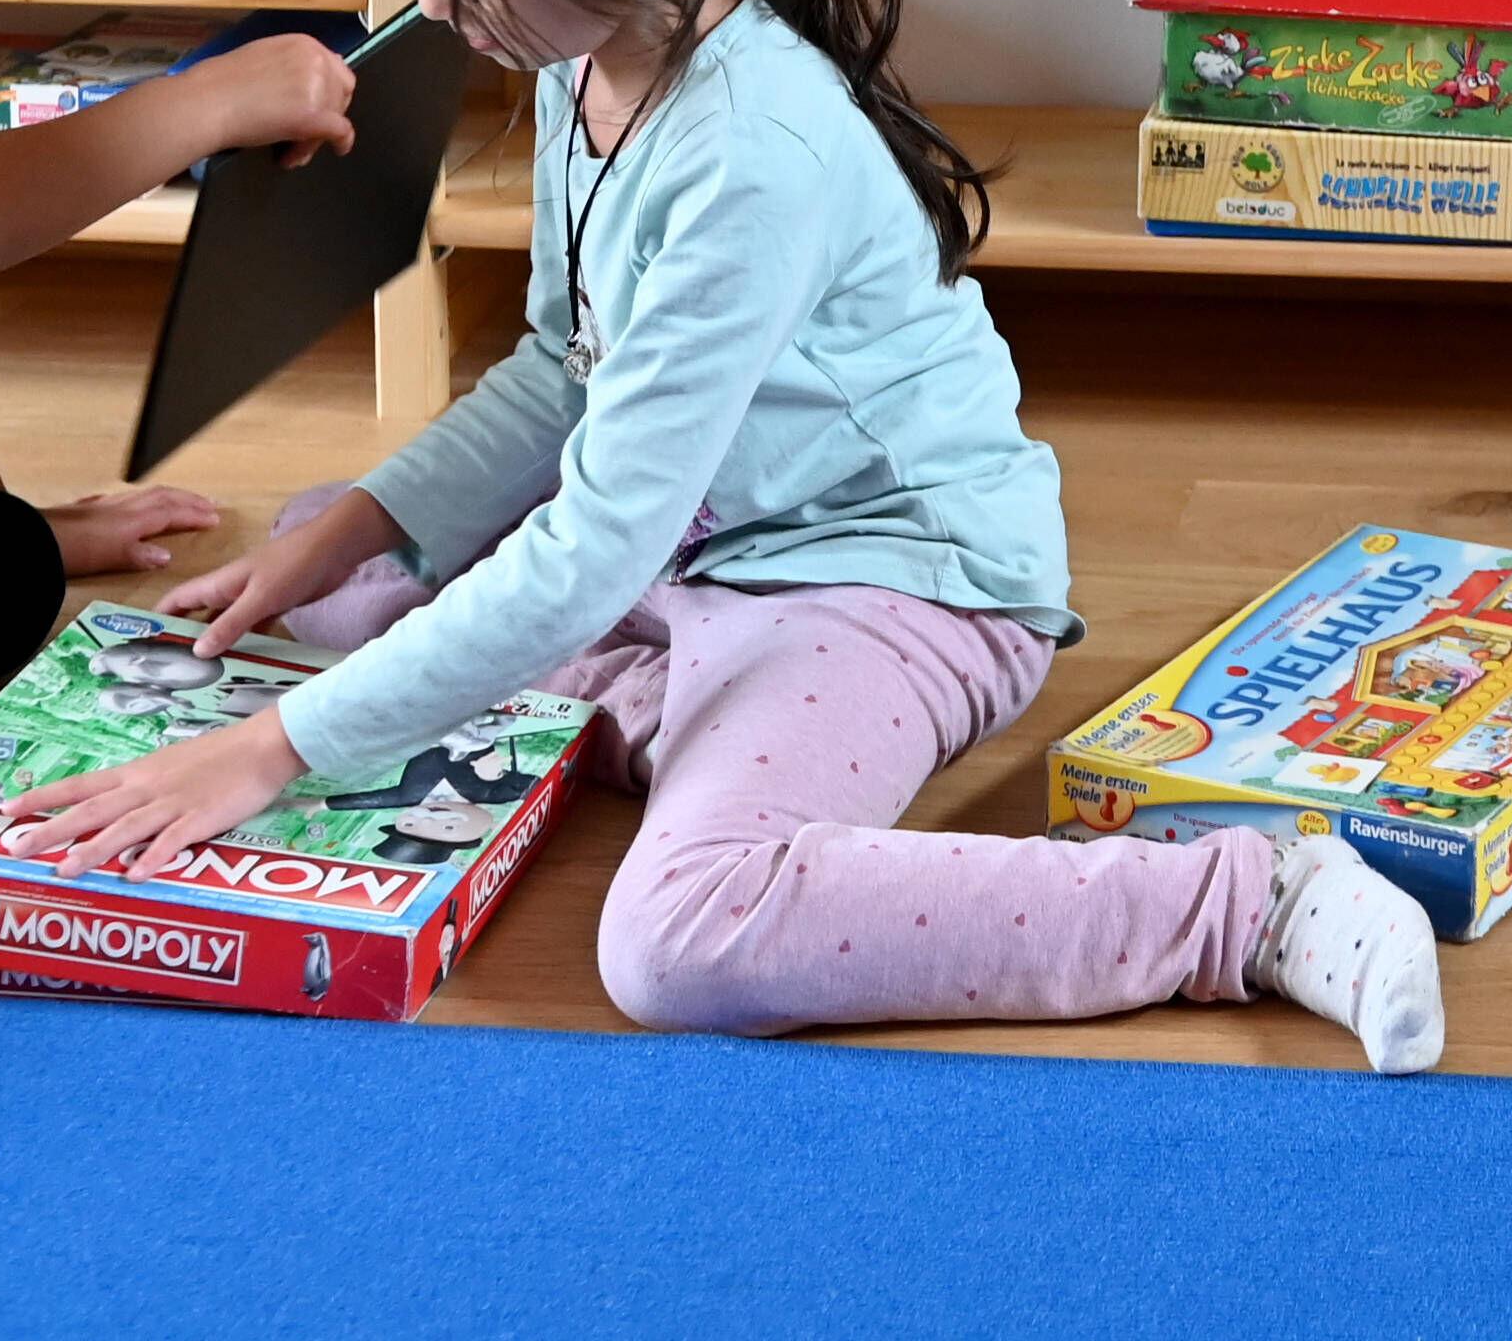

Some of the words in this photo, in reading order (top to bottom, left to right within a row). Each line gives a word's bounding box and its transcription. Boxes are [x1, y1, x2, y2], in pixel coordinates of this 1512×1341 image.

[1208, 560, 1441, 726] SPIELHAUS
[1060, 763, 1101, 787] Meine
[1104, 771, 1147, 794] ersten
[470, 783, 552, 917] MONOPOLY
[1349, 817, 1465, 854] Ravensburger
[0, 914, 234, 973] MONOPOLY
